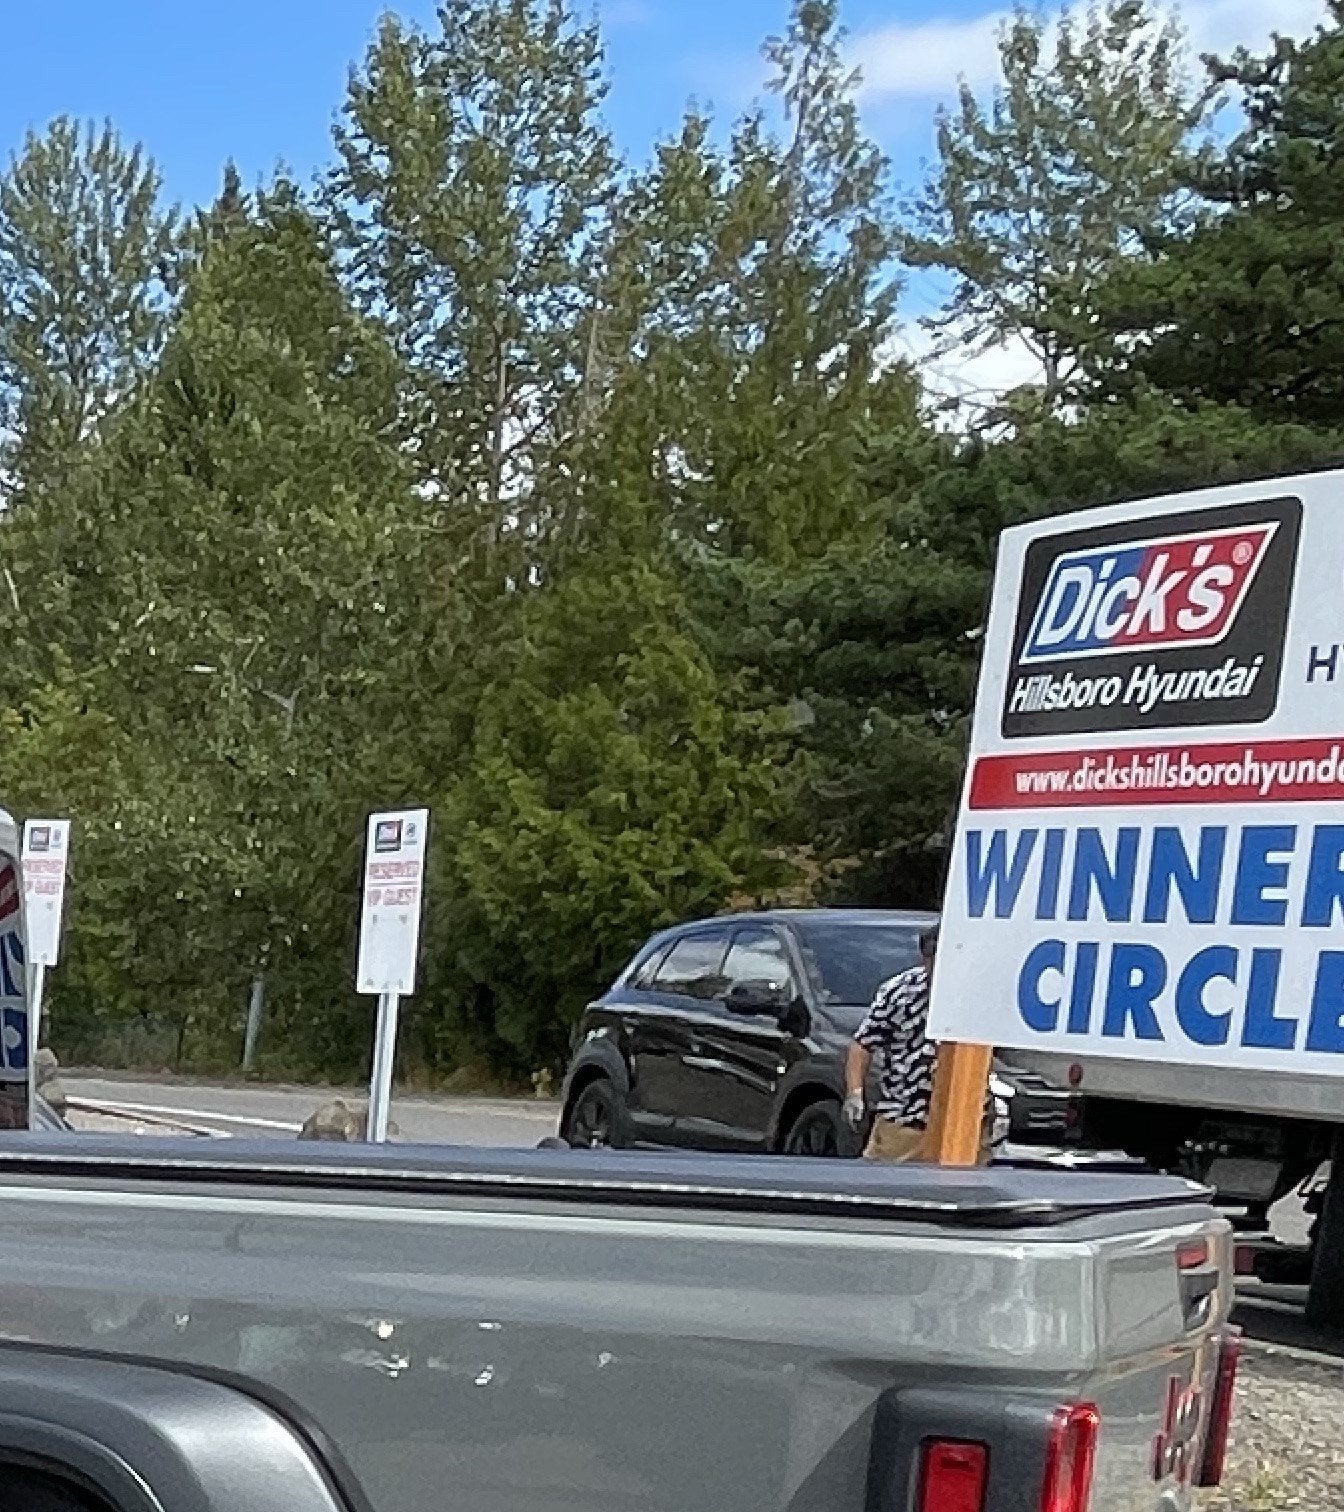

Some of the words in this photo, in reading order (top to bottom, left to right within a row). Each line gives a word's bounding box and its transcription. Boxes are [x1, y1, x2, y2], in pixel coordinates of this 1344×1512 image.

[1033, 545, 1235, 646] Dick's
[1009, 671, 1122, 714] Hillsboro
[1123, 654, 1265, 714] Hyundai
